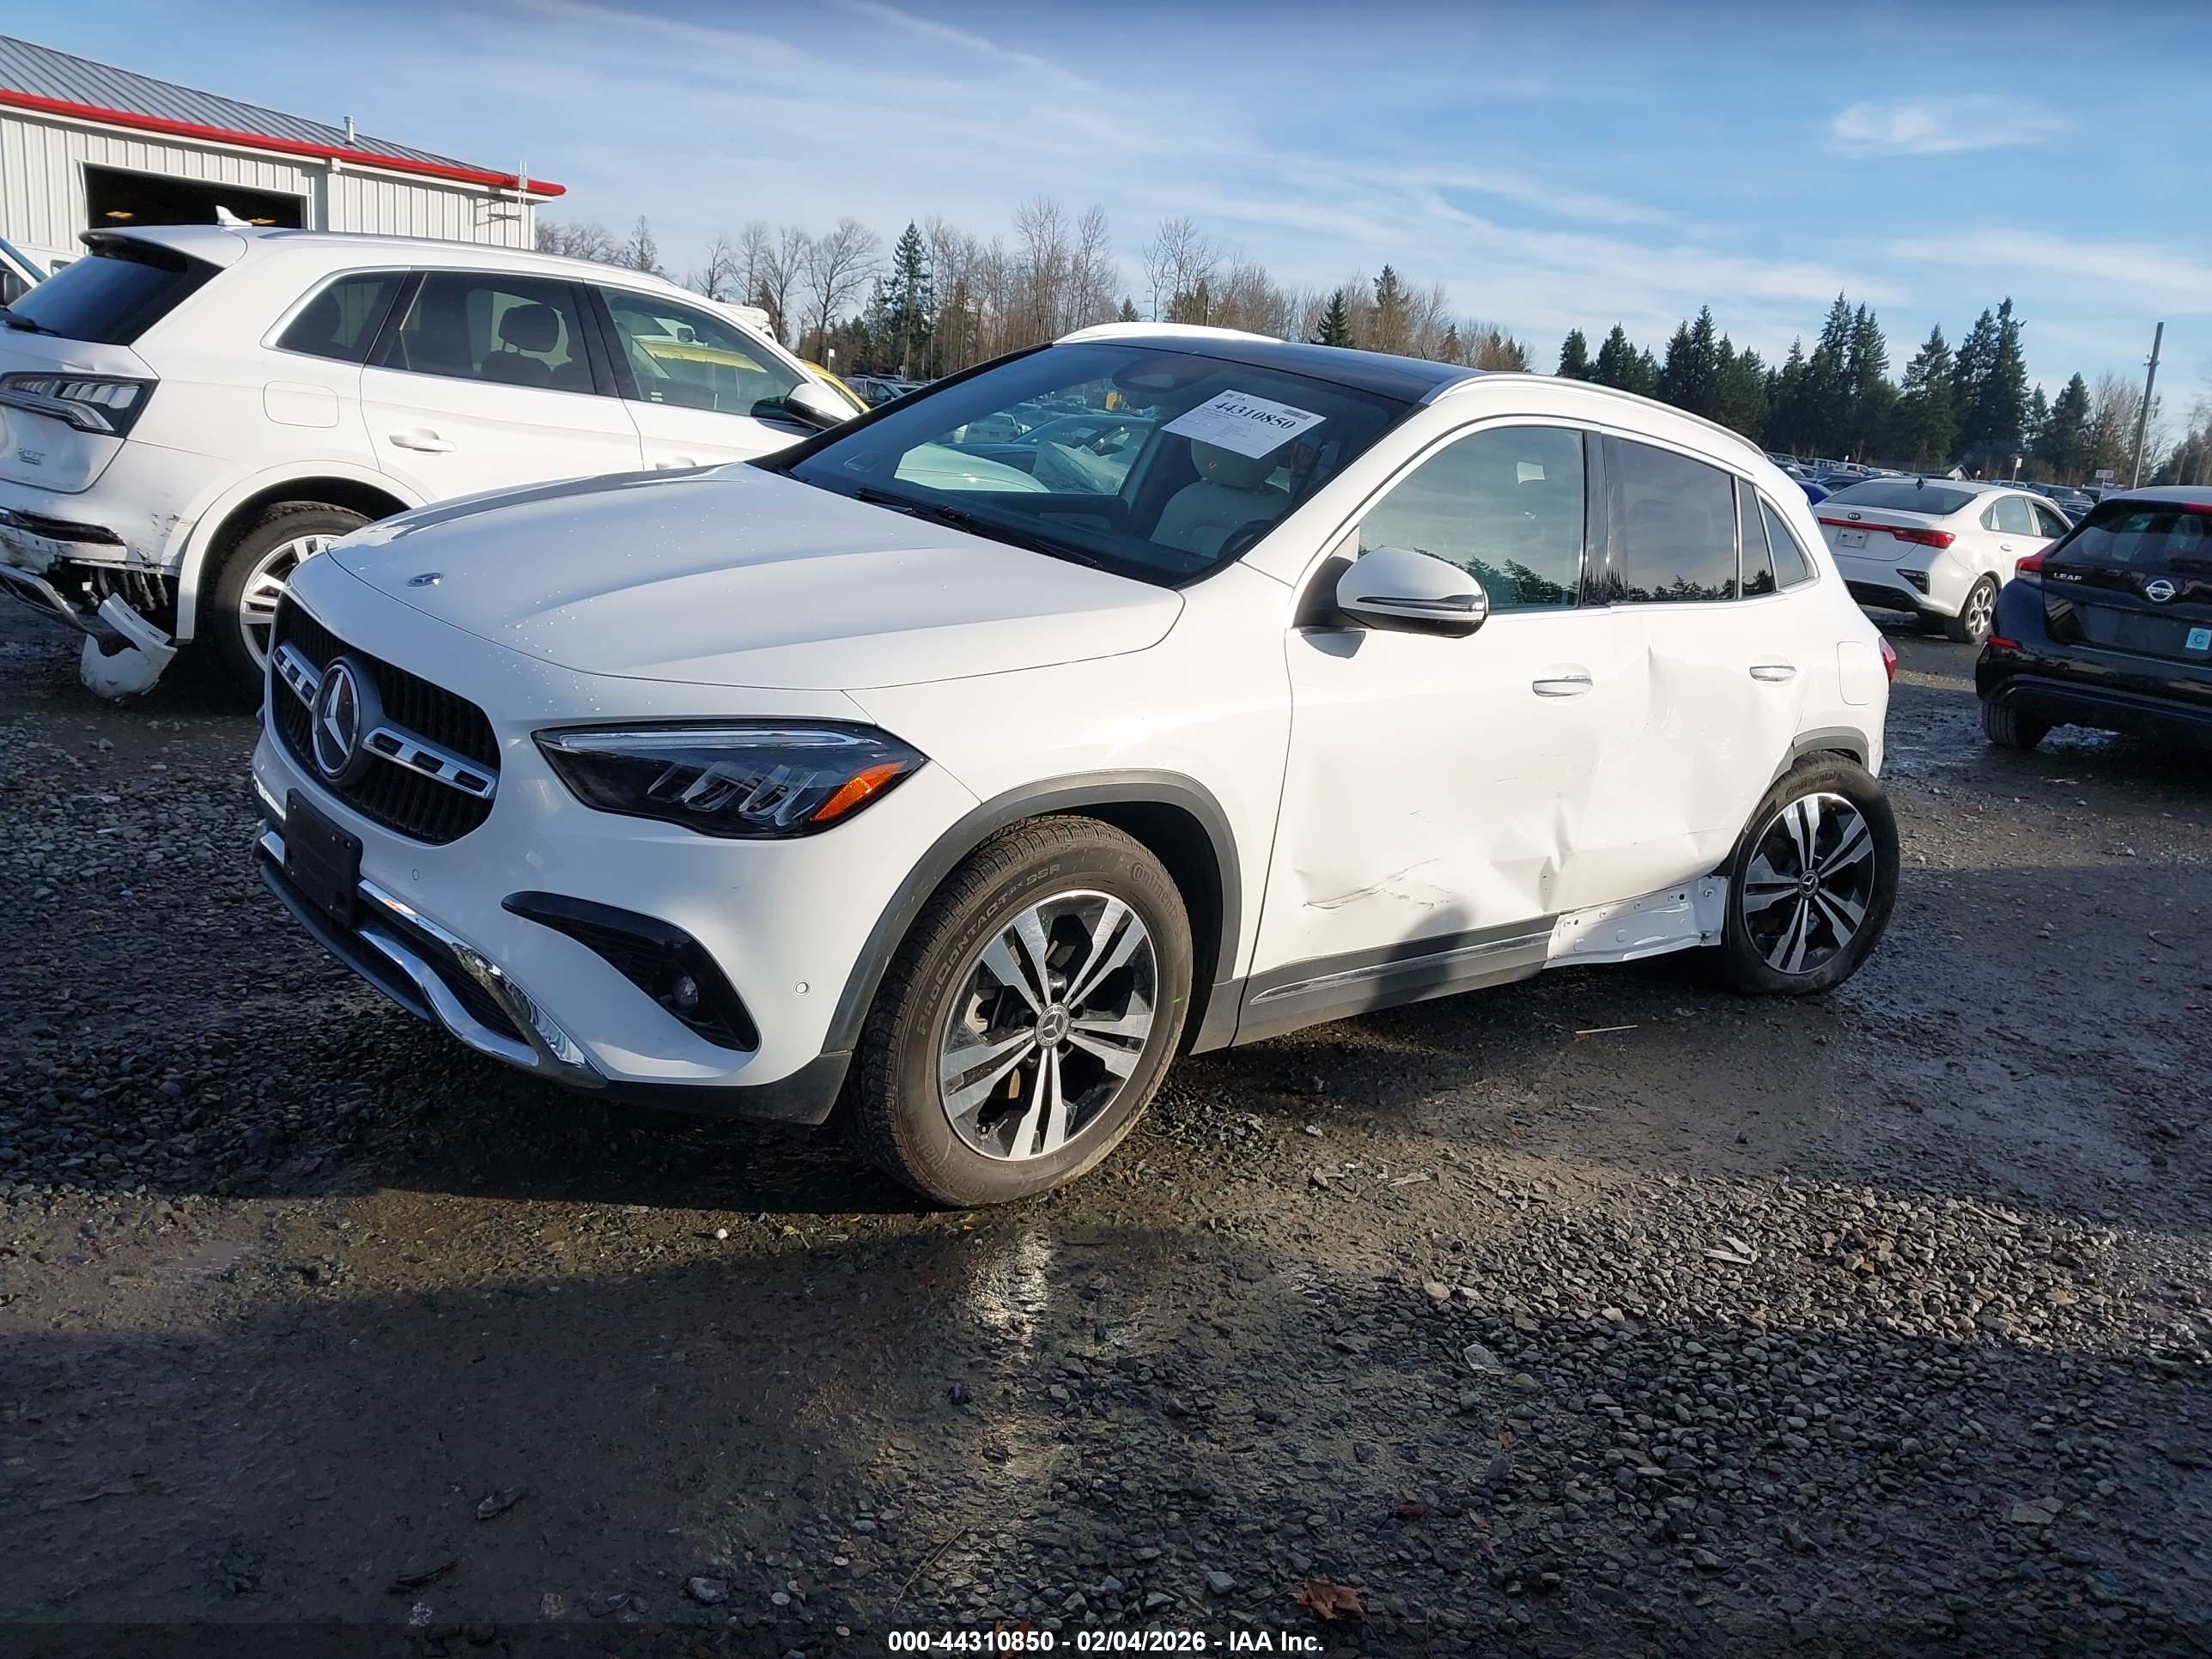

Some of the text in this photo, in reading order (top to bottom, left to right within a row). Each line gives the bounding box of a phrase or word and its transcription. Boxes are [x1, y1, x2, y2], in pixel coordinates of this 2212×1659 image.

[1213, 401, 1297, 429] 44310850
[2053, 572, 2082, 581] LEAF
[2194, 634, 2204, 645] C
[1026, 863, 1060, 886] SSR
